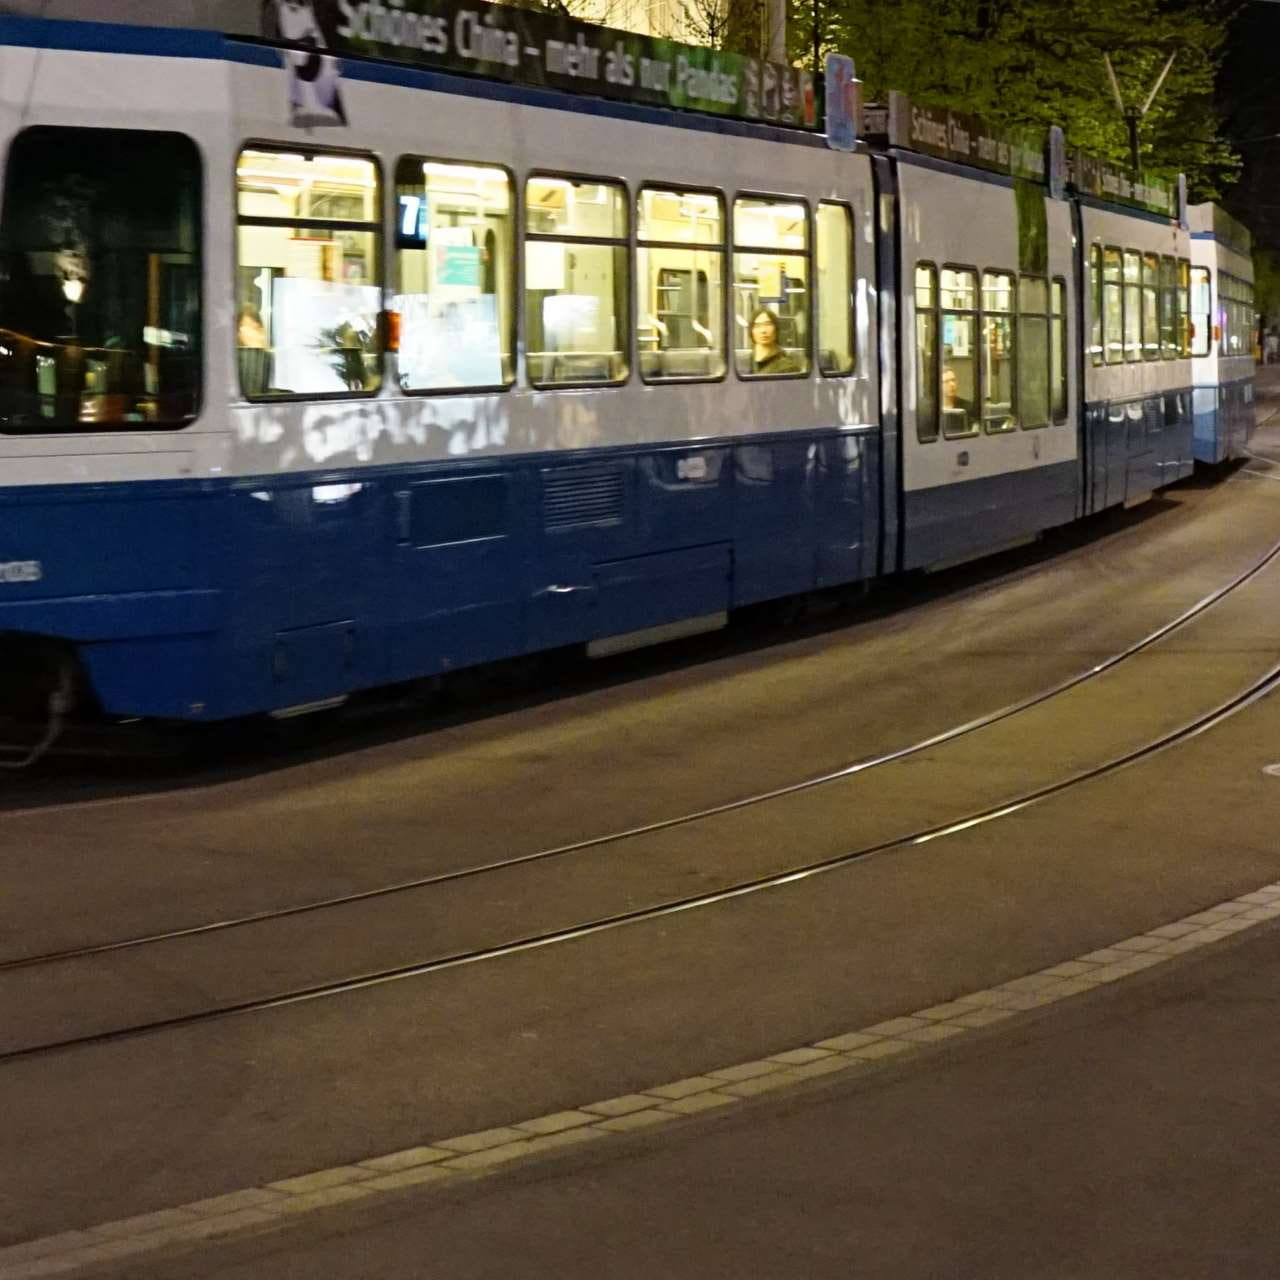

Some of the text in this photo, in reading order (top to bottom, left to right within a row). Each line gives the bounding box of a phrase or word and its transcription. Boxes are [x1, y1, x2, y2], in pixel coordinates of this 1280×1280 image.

[455, 7, 519, 66] China
[605, 40, 634, 86] als
[400, 196, 420, 235] 7
